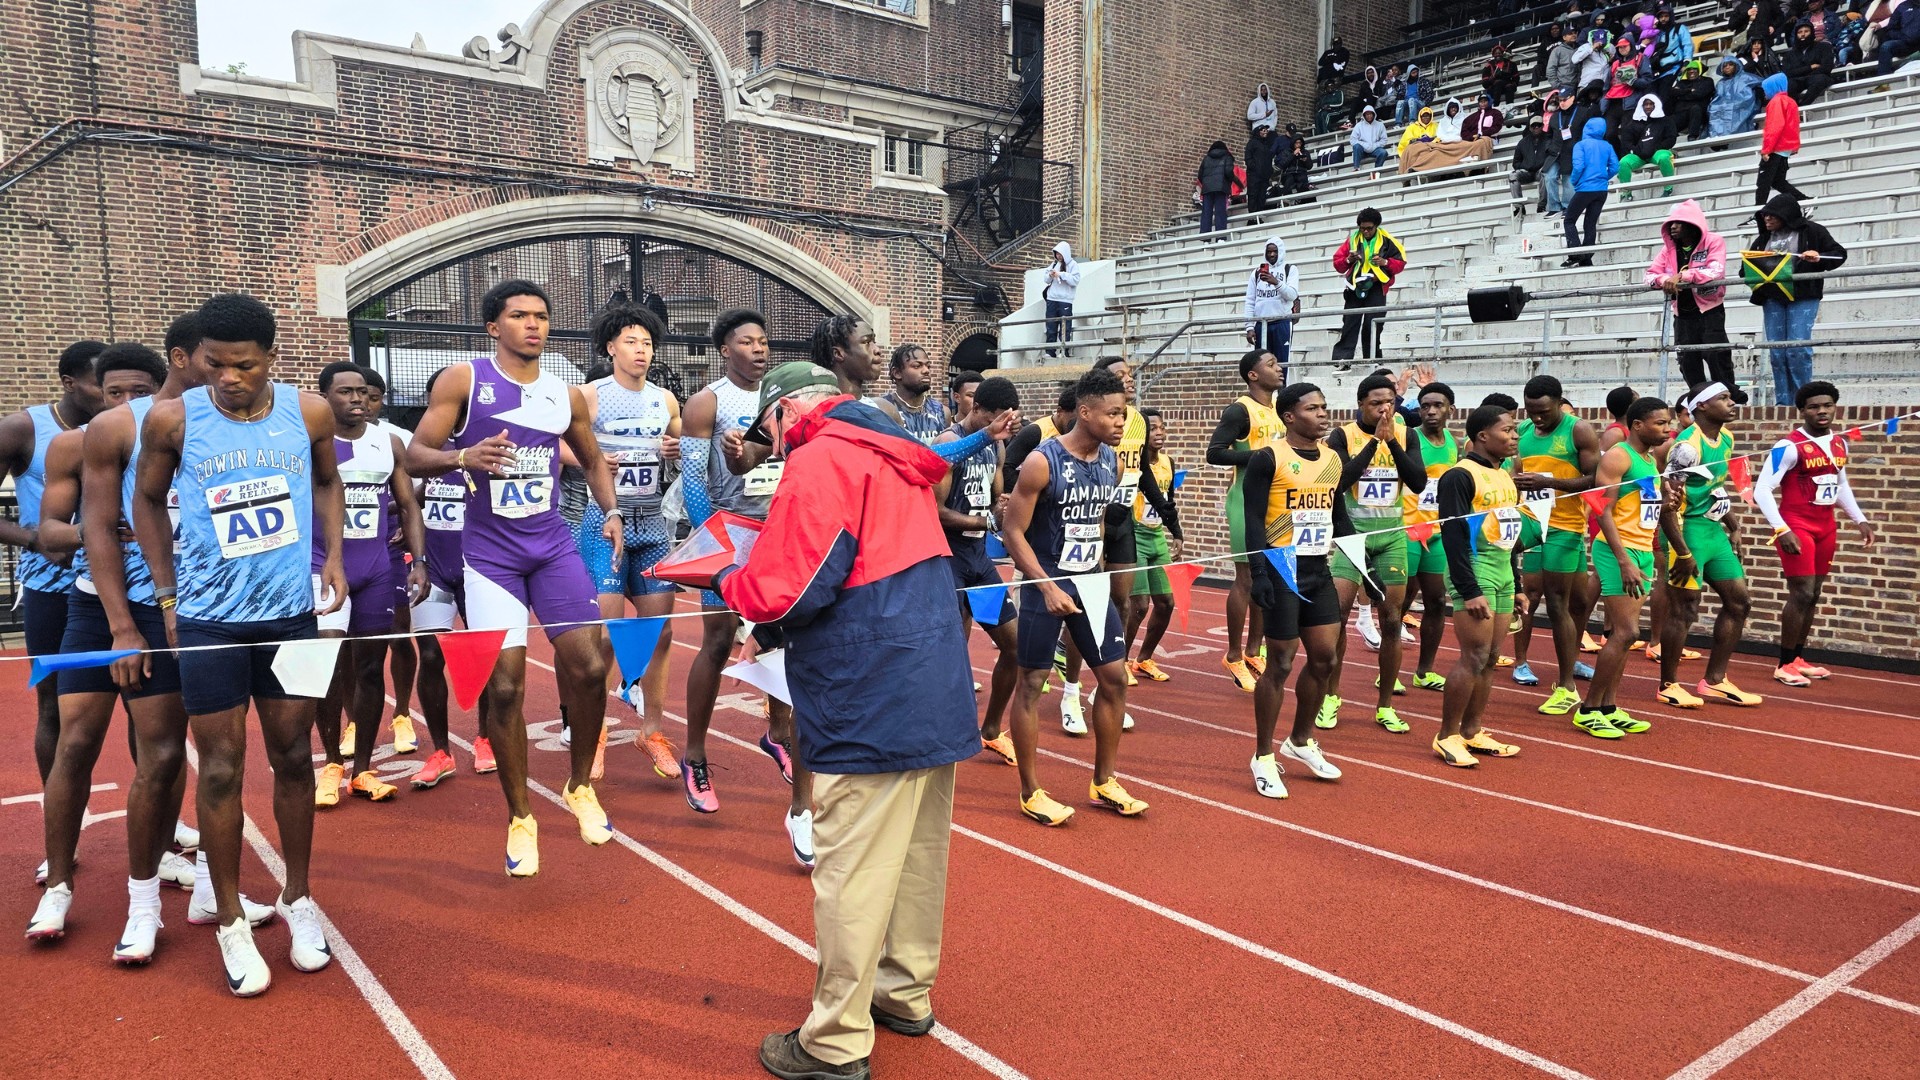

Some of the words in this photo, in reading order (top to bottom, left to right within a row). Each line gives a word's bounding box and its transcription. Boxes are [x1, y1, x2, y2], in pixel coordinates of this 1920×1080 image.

[1405, 334, 1410, 342] 5
[194, 449, 250, 482] EDWIN
[254, 448, 305, 478] ALLEN
[619, 467, 653, 487] AB
[239, 480, 268, 493] PENN
[239, 486, 279, 500] RELAYS
[500, 480, 544, 506] AC
[1363, 482, 1392, 499] AF
[1526, 487, 1550, 501] AG
[1111, 488, 1133, 504] AE
[1286, 487, 1335, 509] EAGLES
[427, 502, 457, 522] AC
[1711, 501, 1729, 514] AH
[227, 506, 285, 544] AD
[1503, 523, 1519, 541] AF
[1297, 528, 1327, 546] AE
[1065, 543, 1097, 563] AA
